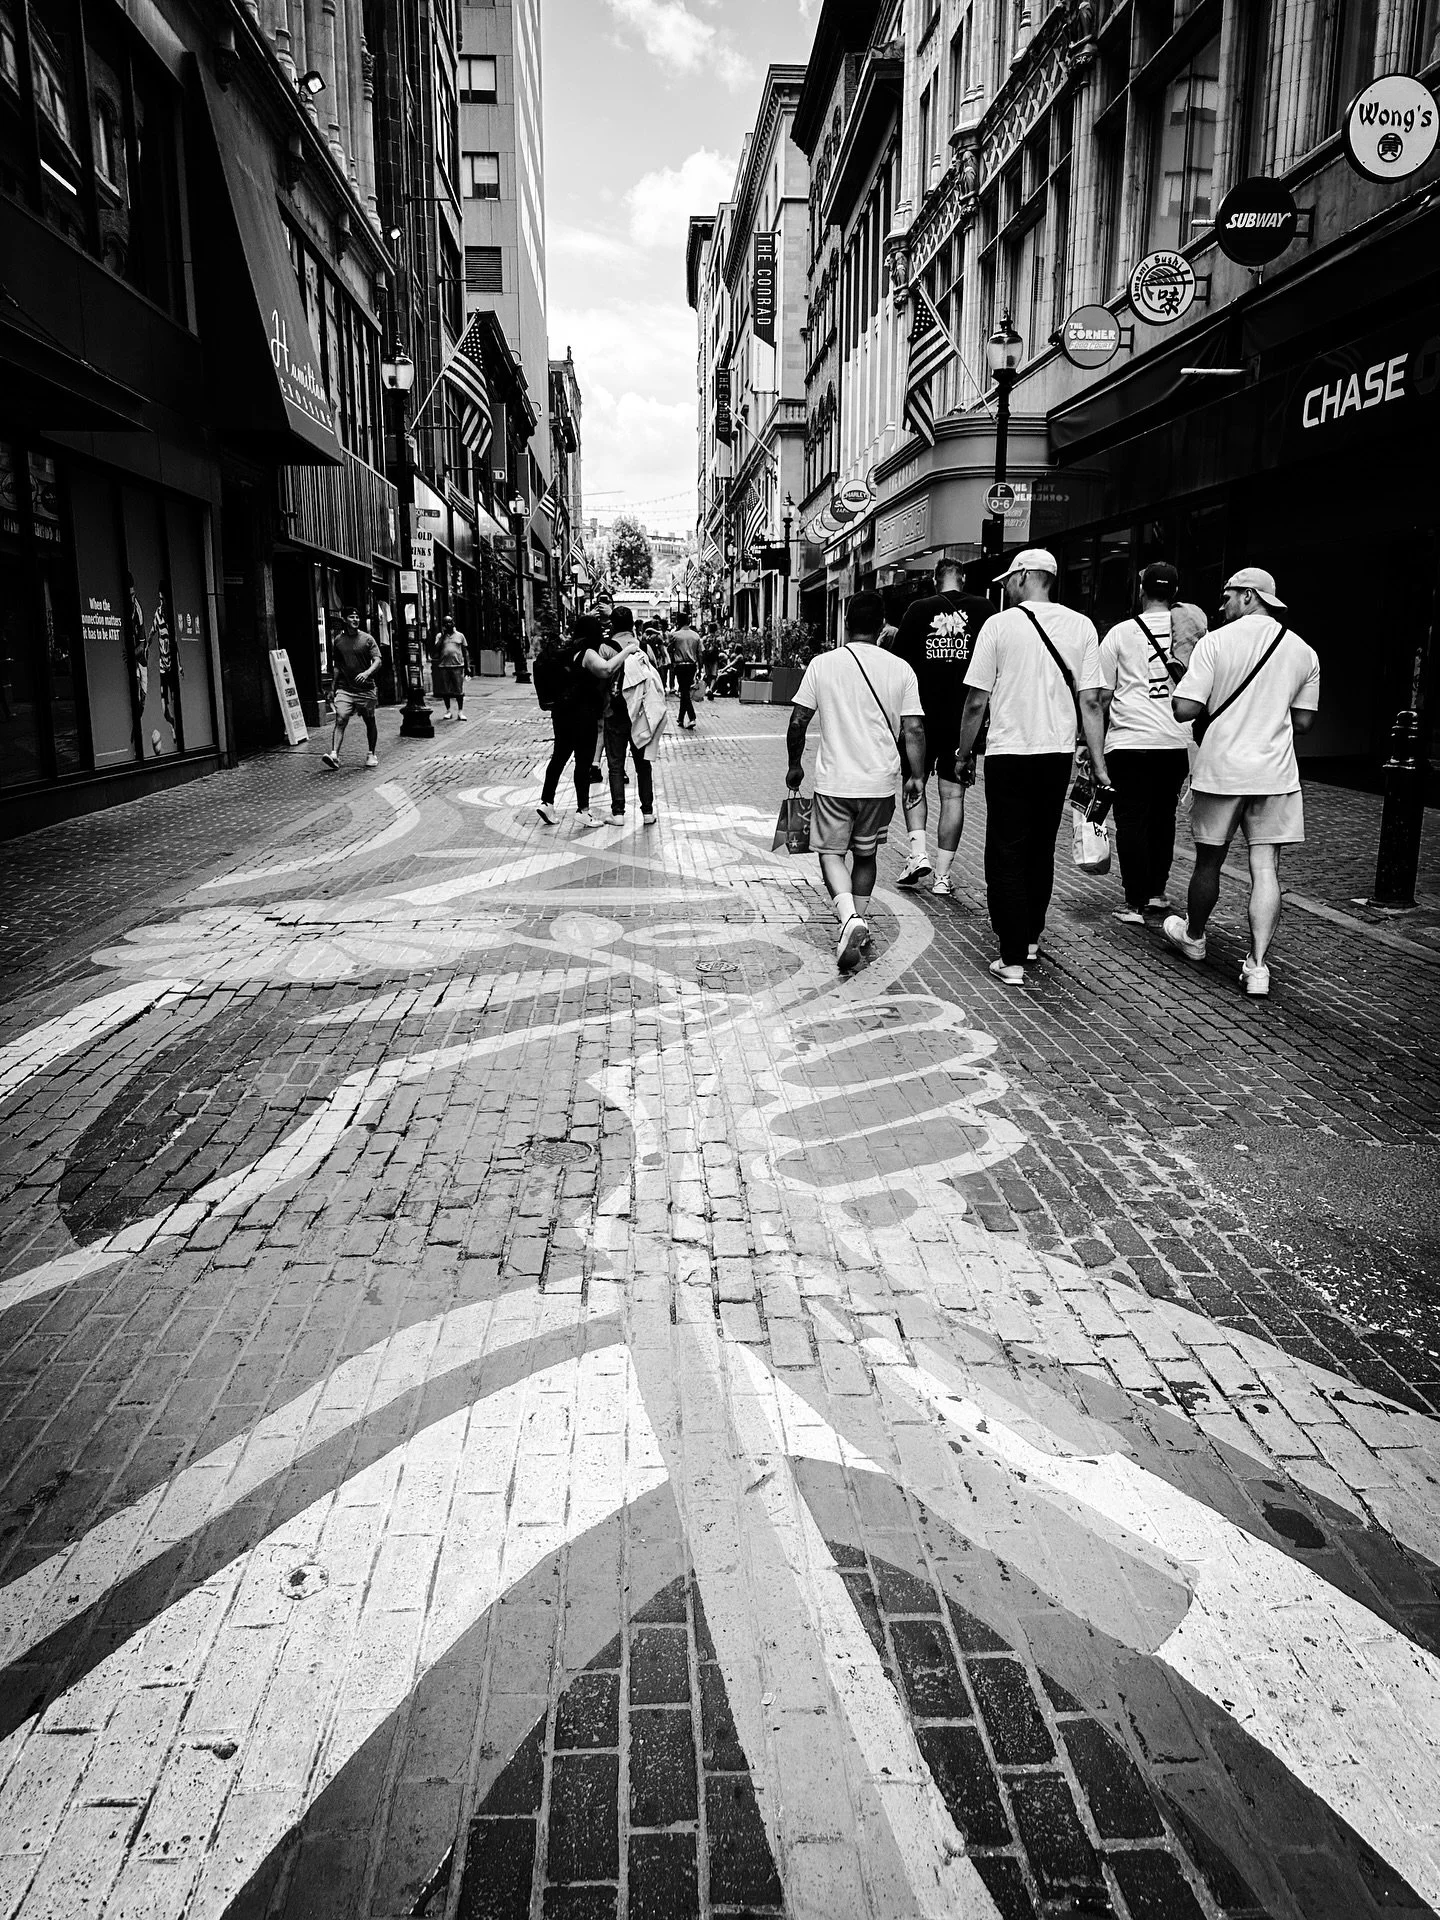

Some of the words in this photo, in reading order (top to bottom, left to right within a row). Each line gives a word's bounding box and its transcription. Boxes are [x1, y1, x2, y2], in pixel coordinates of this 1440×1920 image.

[1358, 102, 1433, 133] Wong's
[1225, 211, 1292, 230] SUBWAY
[757, 235, 772, 262] THE
[1133, 261, 1150, 302] Umami
[1154, 254, 1184, 270] Sushi
[757, 268, 772, 325] CONRAD
[1068, 329, 1116, 341] CORNER
[1069, 322, 1084, 330] THE
[270, 308, 327, 405] Hamilton
[718, 371, 729, 389] THE
[1302, 352, 1409, 429] CHASE
[280, 377, 332, 428] CROSSING
[997, 485, 1006, 497] F
[89, 597, 102, 610] When
[105, 616, 121, 627] matters
[83, 627, 87, 639] it
[88, 627, 96, 639] has
[97, 629, 102, 640] to
[102, 628, 108, 640] be
[109, 629, 120, 640] AT&T
[954, 633, 972, 650] of
